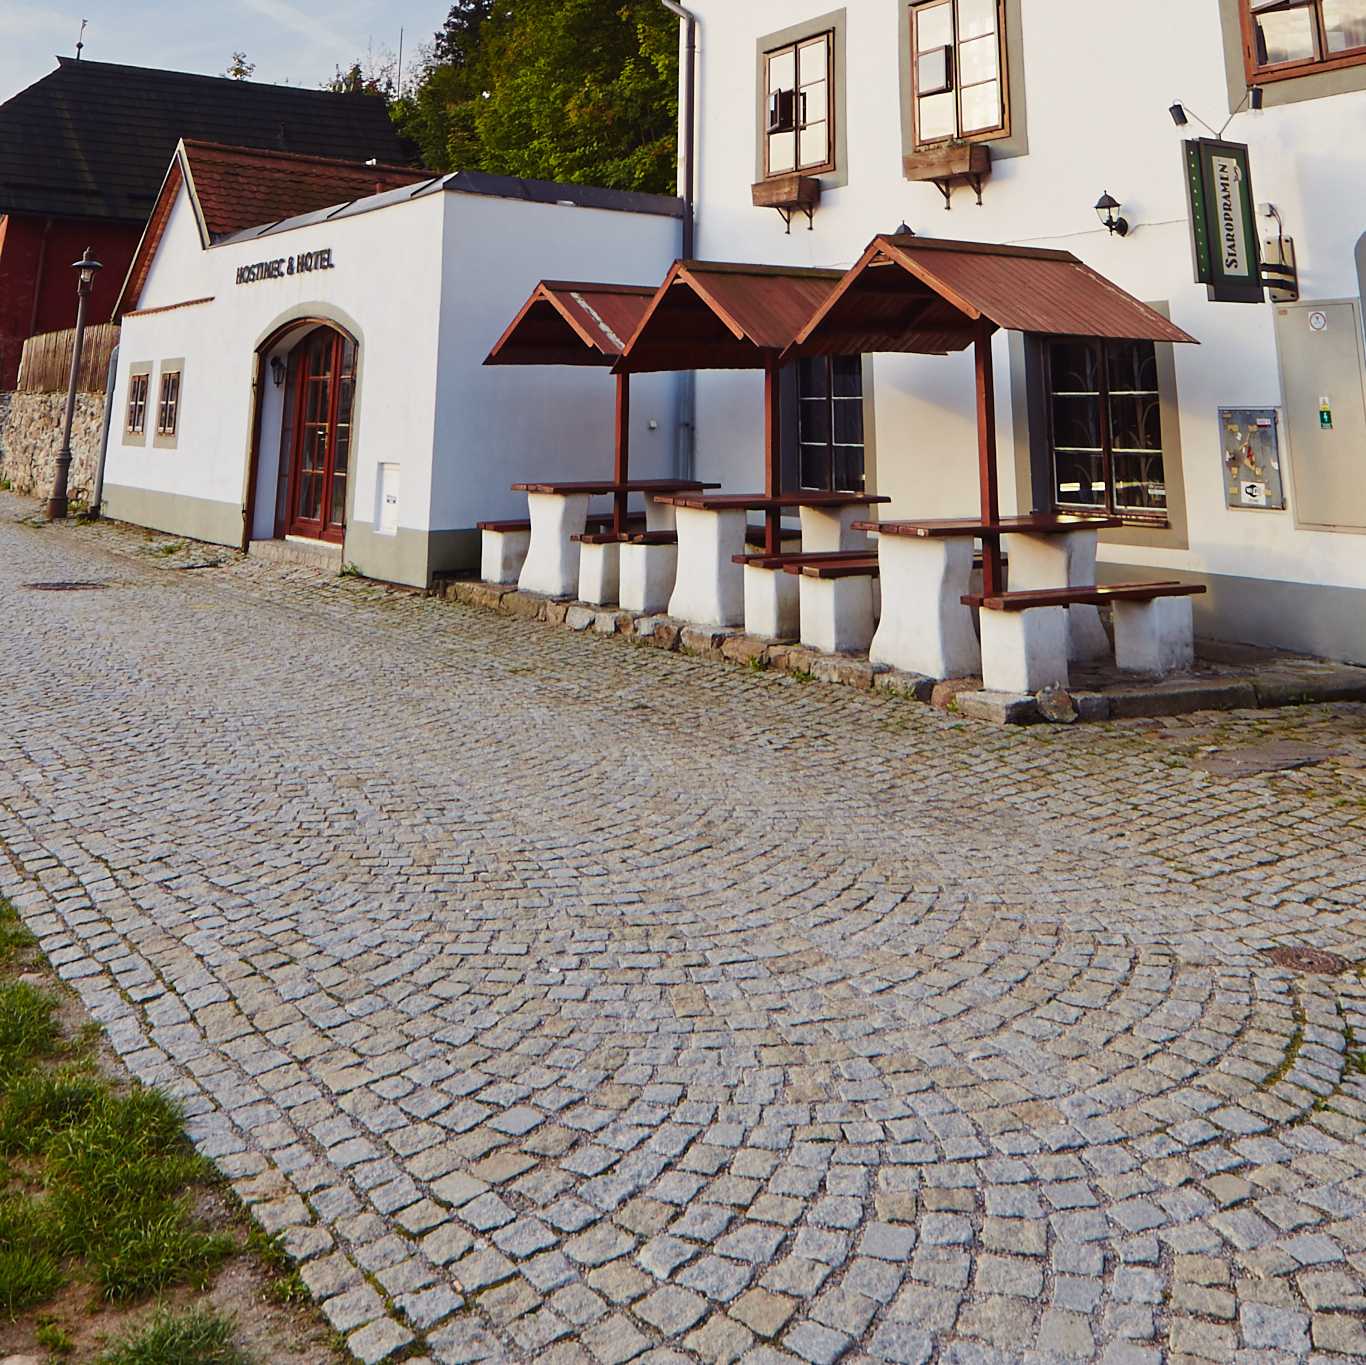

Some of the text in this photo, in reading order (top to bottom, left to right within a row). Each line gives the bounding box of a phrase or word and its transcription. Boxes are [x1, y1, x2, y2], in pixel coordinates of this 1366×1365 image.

[1218, 163, 1238, 269] STAROPRAMEN
[236, 248, 335, 285] HOSTINEC & HOTEL
